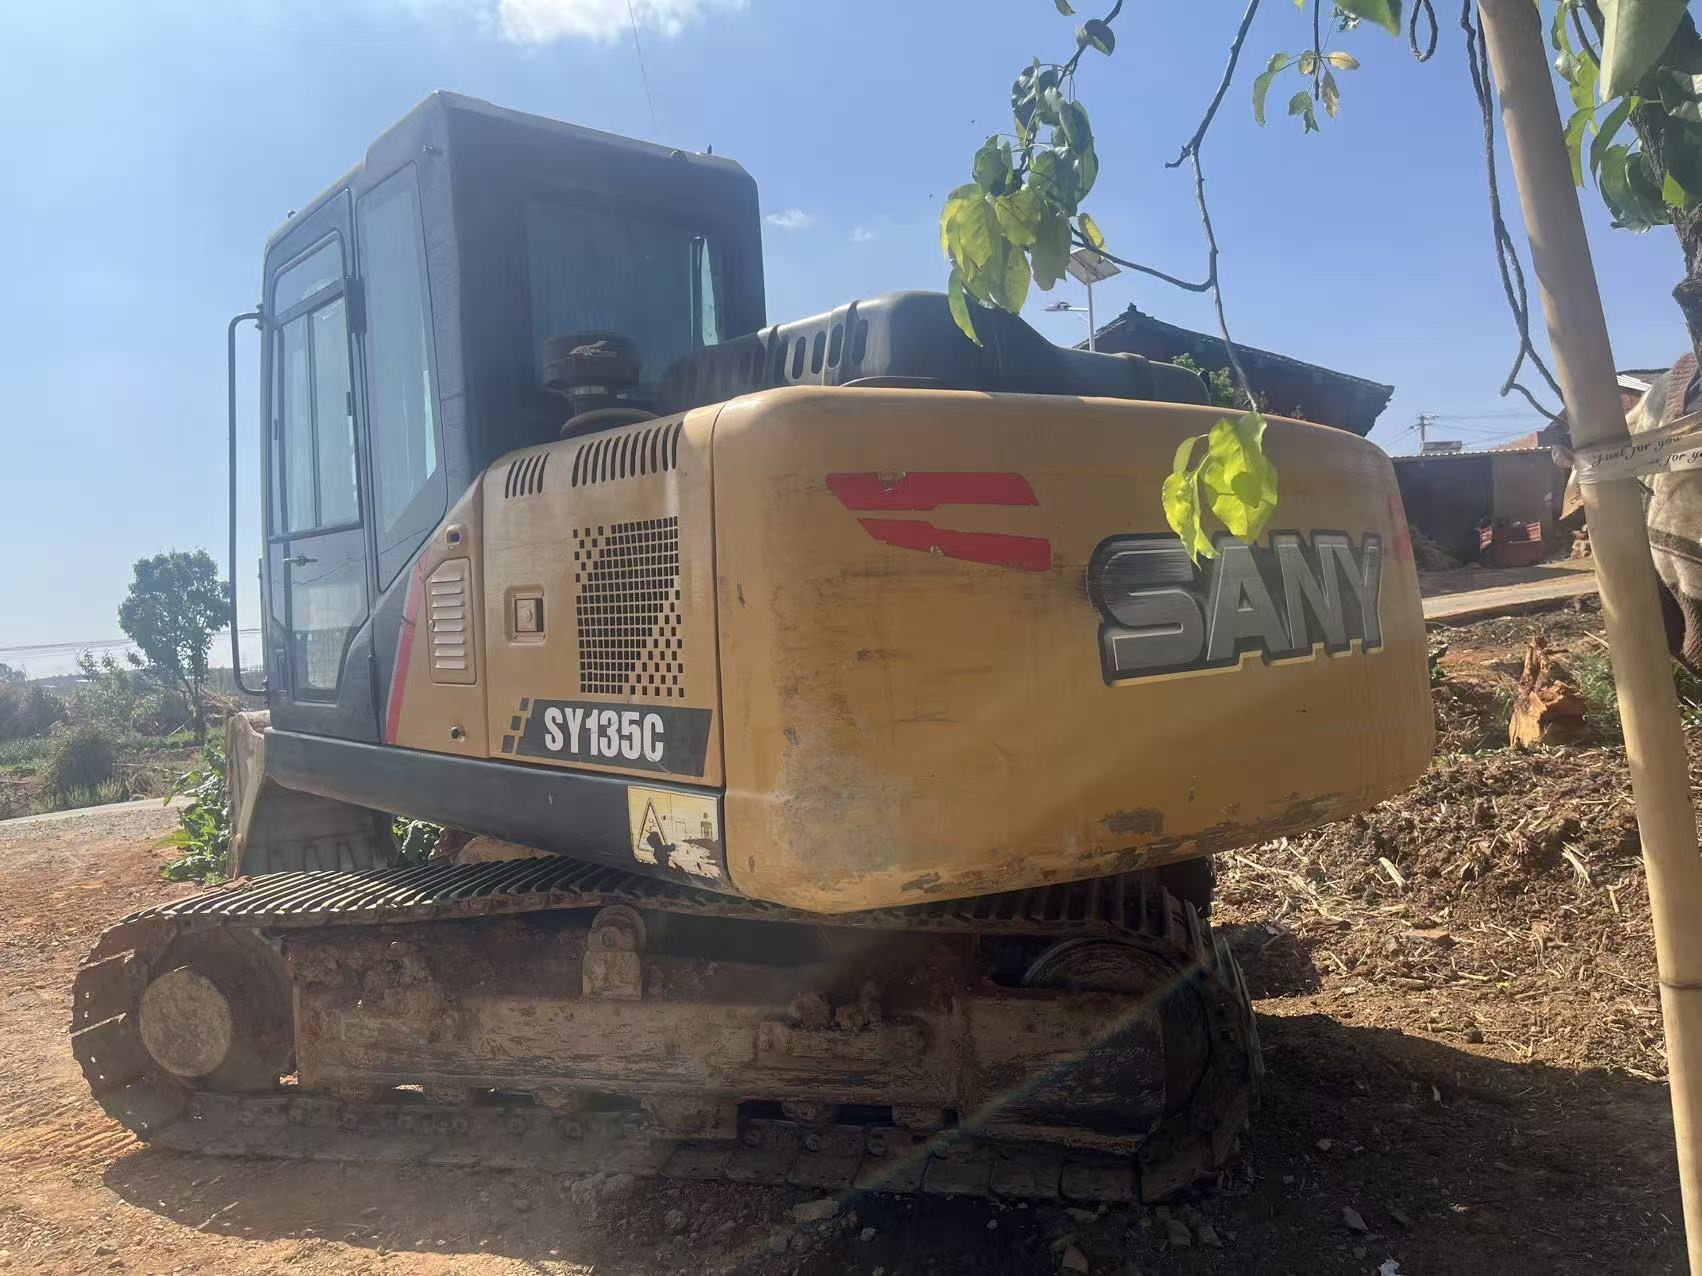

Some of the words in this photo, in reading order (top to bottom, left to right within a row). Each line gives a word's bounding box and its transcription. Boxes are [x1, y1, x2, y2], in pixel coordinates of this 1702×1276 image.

[1659, 453, 1687, 468] for
[1089, 531, 1384, 685] SANY
[544, 706, 665, 763] SY135C
